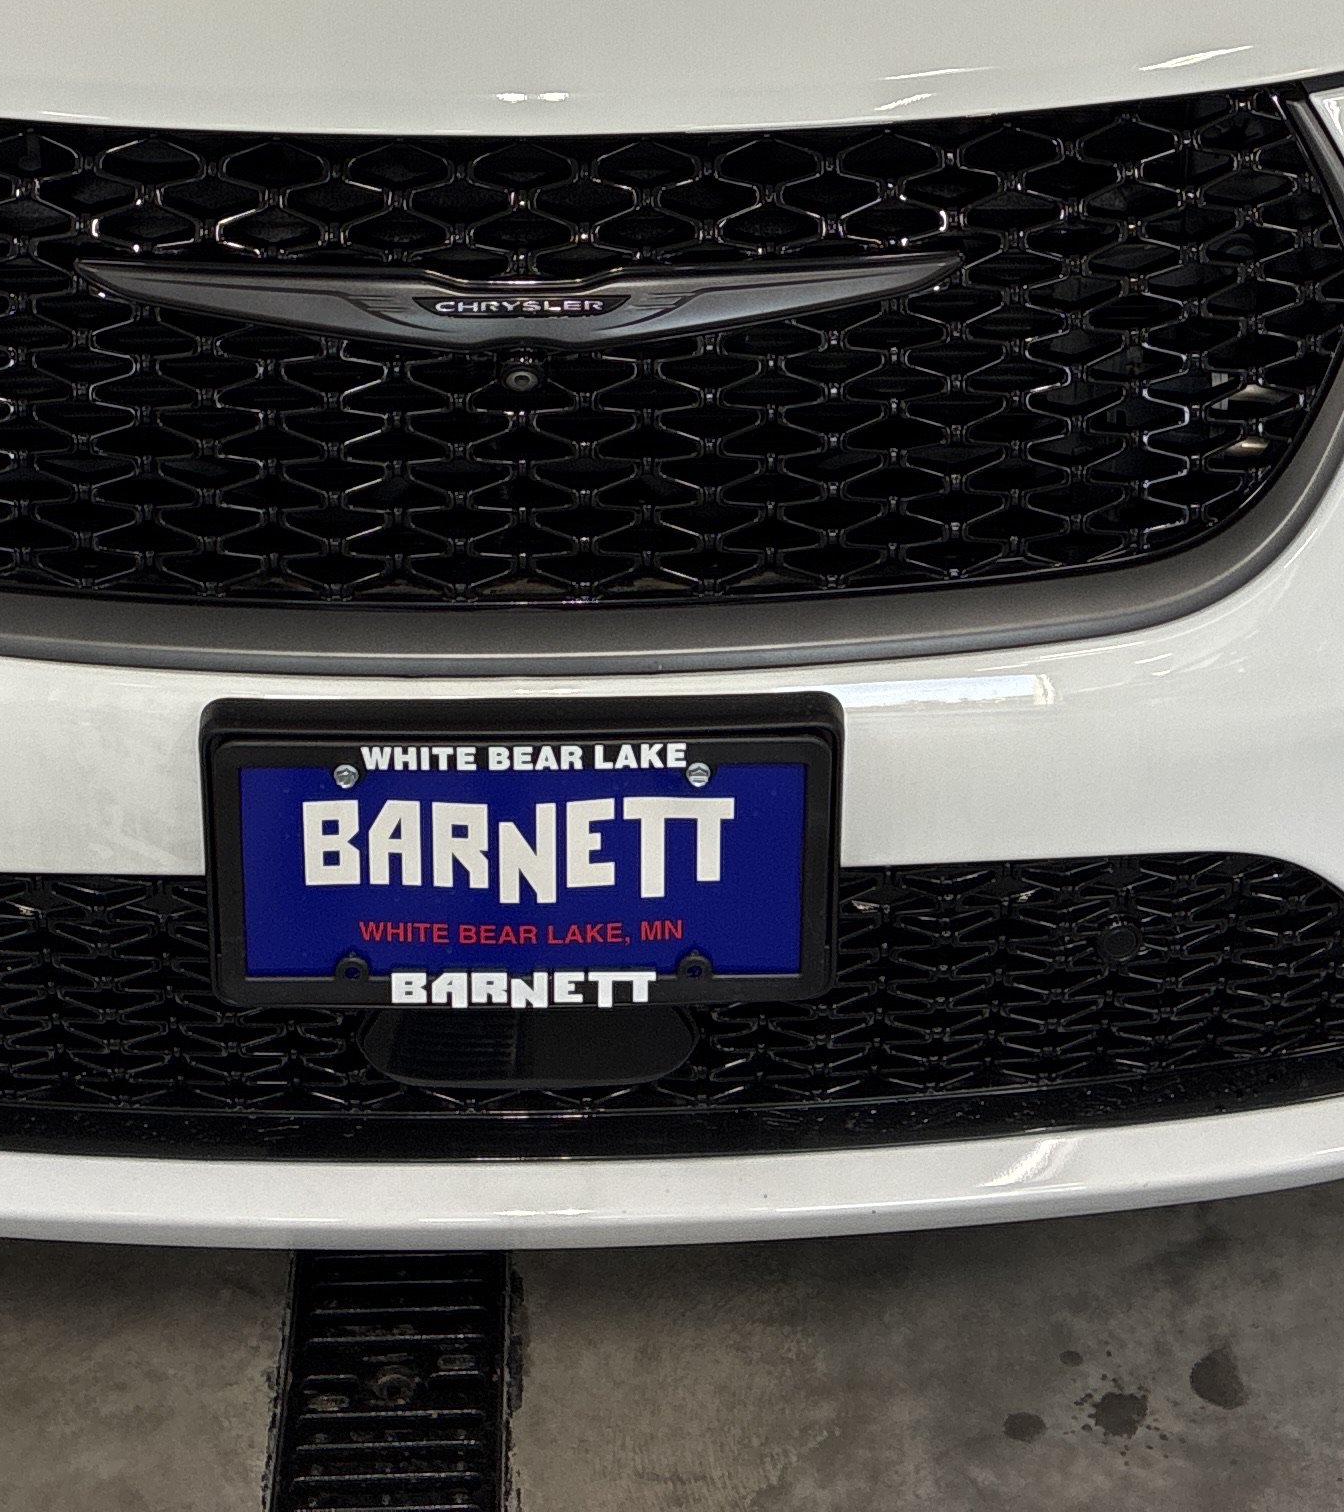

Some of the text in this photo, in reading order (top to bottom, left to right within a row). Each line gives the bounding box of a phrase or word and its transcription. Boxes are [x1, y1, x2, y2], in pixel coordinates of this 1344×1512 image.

[434, 300, 604, 313] CHRYSLER
[360, 742, 688, 771] WHITE BEAR LAKE
[302, 796, 735, 904] BARNETT
[358, 919, 683, 946] WHITE BEAR LAKE, MN
[390, 971, 657, 1009] BARNETT
